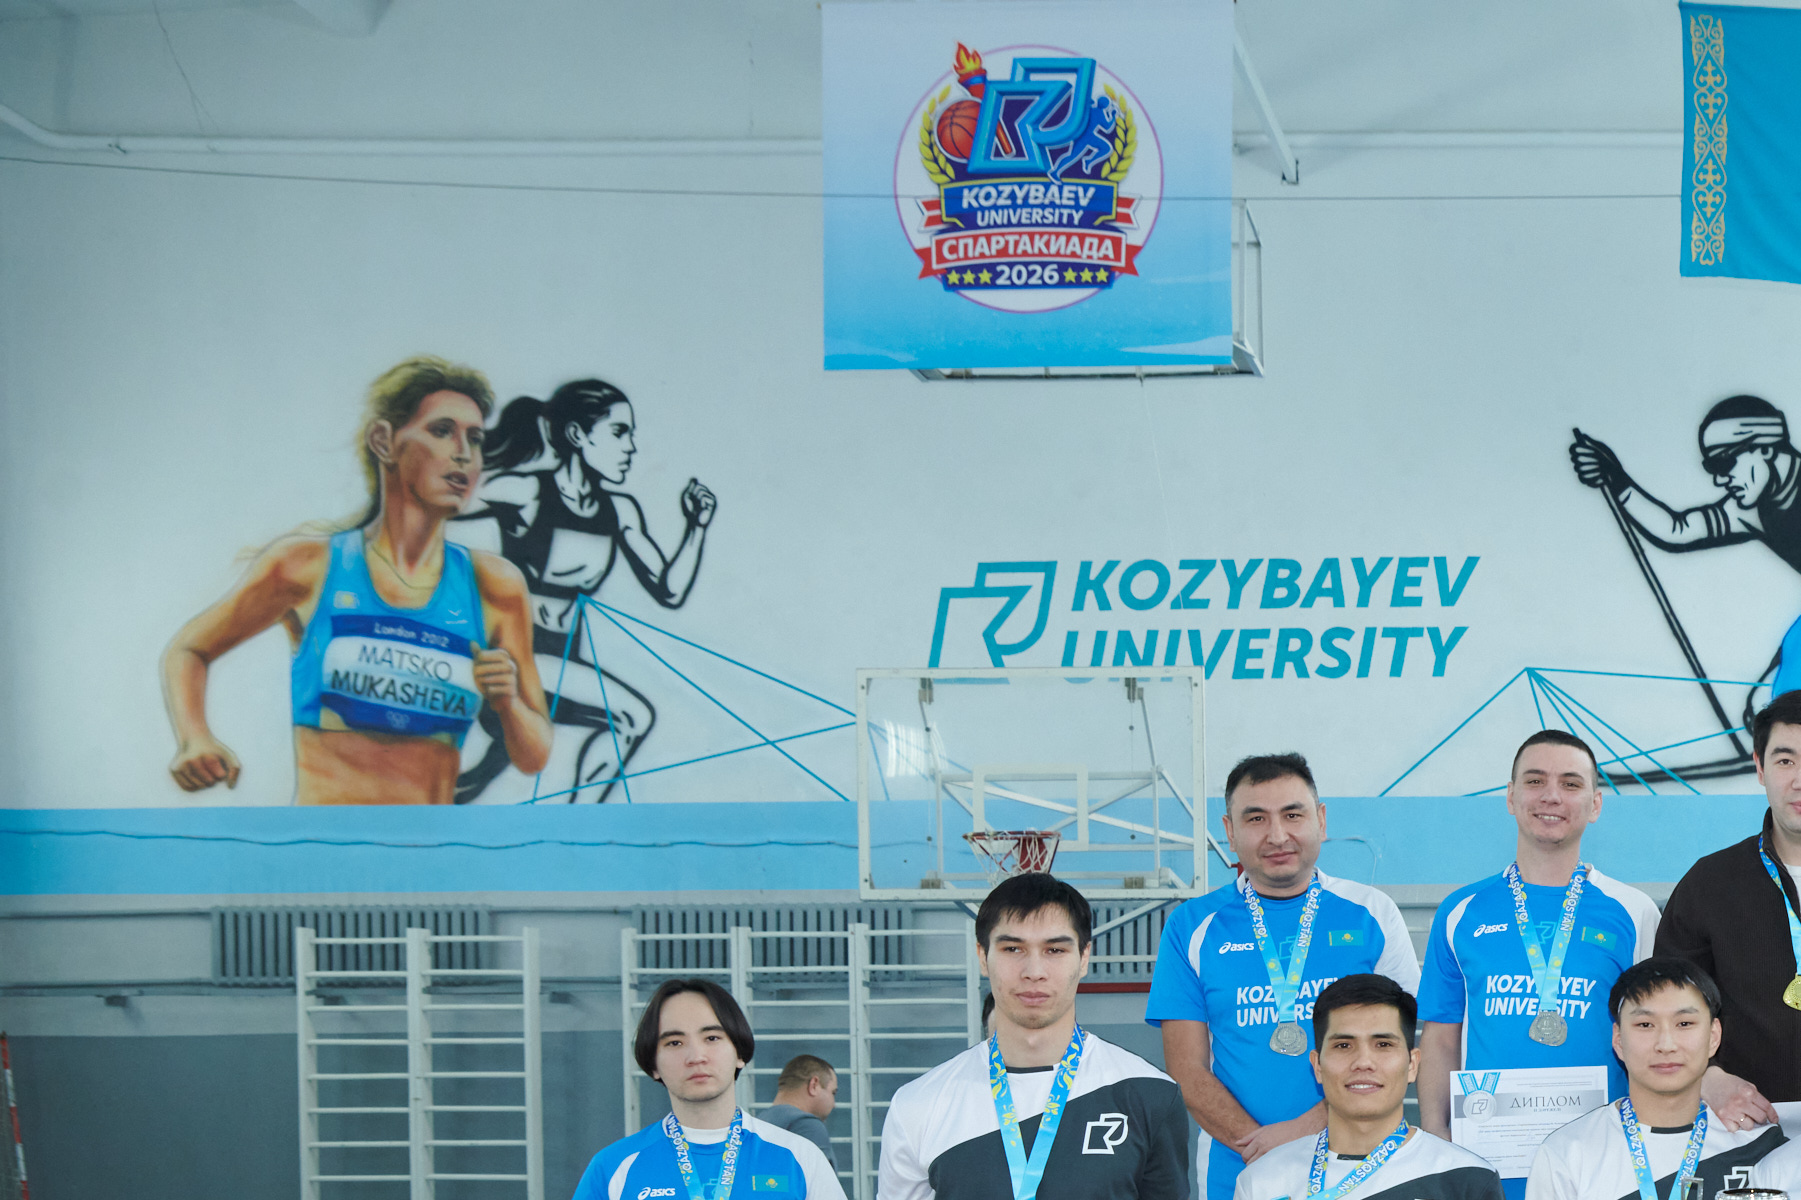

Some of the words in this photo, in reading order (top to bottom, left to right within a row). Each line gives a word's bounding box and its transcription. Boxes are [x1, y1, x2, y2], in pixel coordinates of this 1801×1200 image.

[962, 184, 1096, 209] KOZYBAEV
[976, 208, 1084, 227] UNIVERSITY
[941, 234, 1115, 261] СПАРТАКИАДА
[995, 264, 1060, 286] 2026
[1070, 556, 1481, 612] KOZYBAYEV
[357, 644, 453, 682] MATSKO
[1060, 626, 1470, 684] UNIVERSITY
[330, 669, 468, 717] MUKASHEVA
[1297, 888, 1320, 948] QAZAQSTAN
[1560, 875, 1583, 932] QAZAQSTAN
[1486, 974, 1597, 996] KOZYYEV
[1484, 997, 1592, 1019] UNIVESITY
[1510, 1095, 1581, 1109] ДИПЛОМ
[720, 1125, 742, 1185] QAZAQSTAN
[1338, 1140, 1396, 1193] QAZAQSTAN
